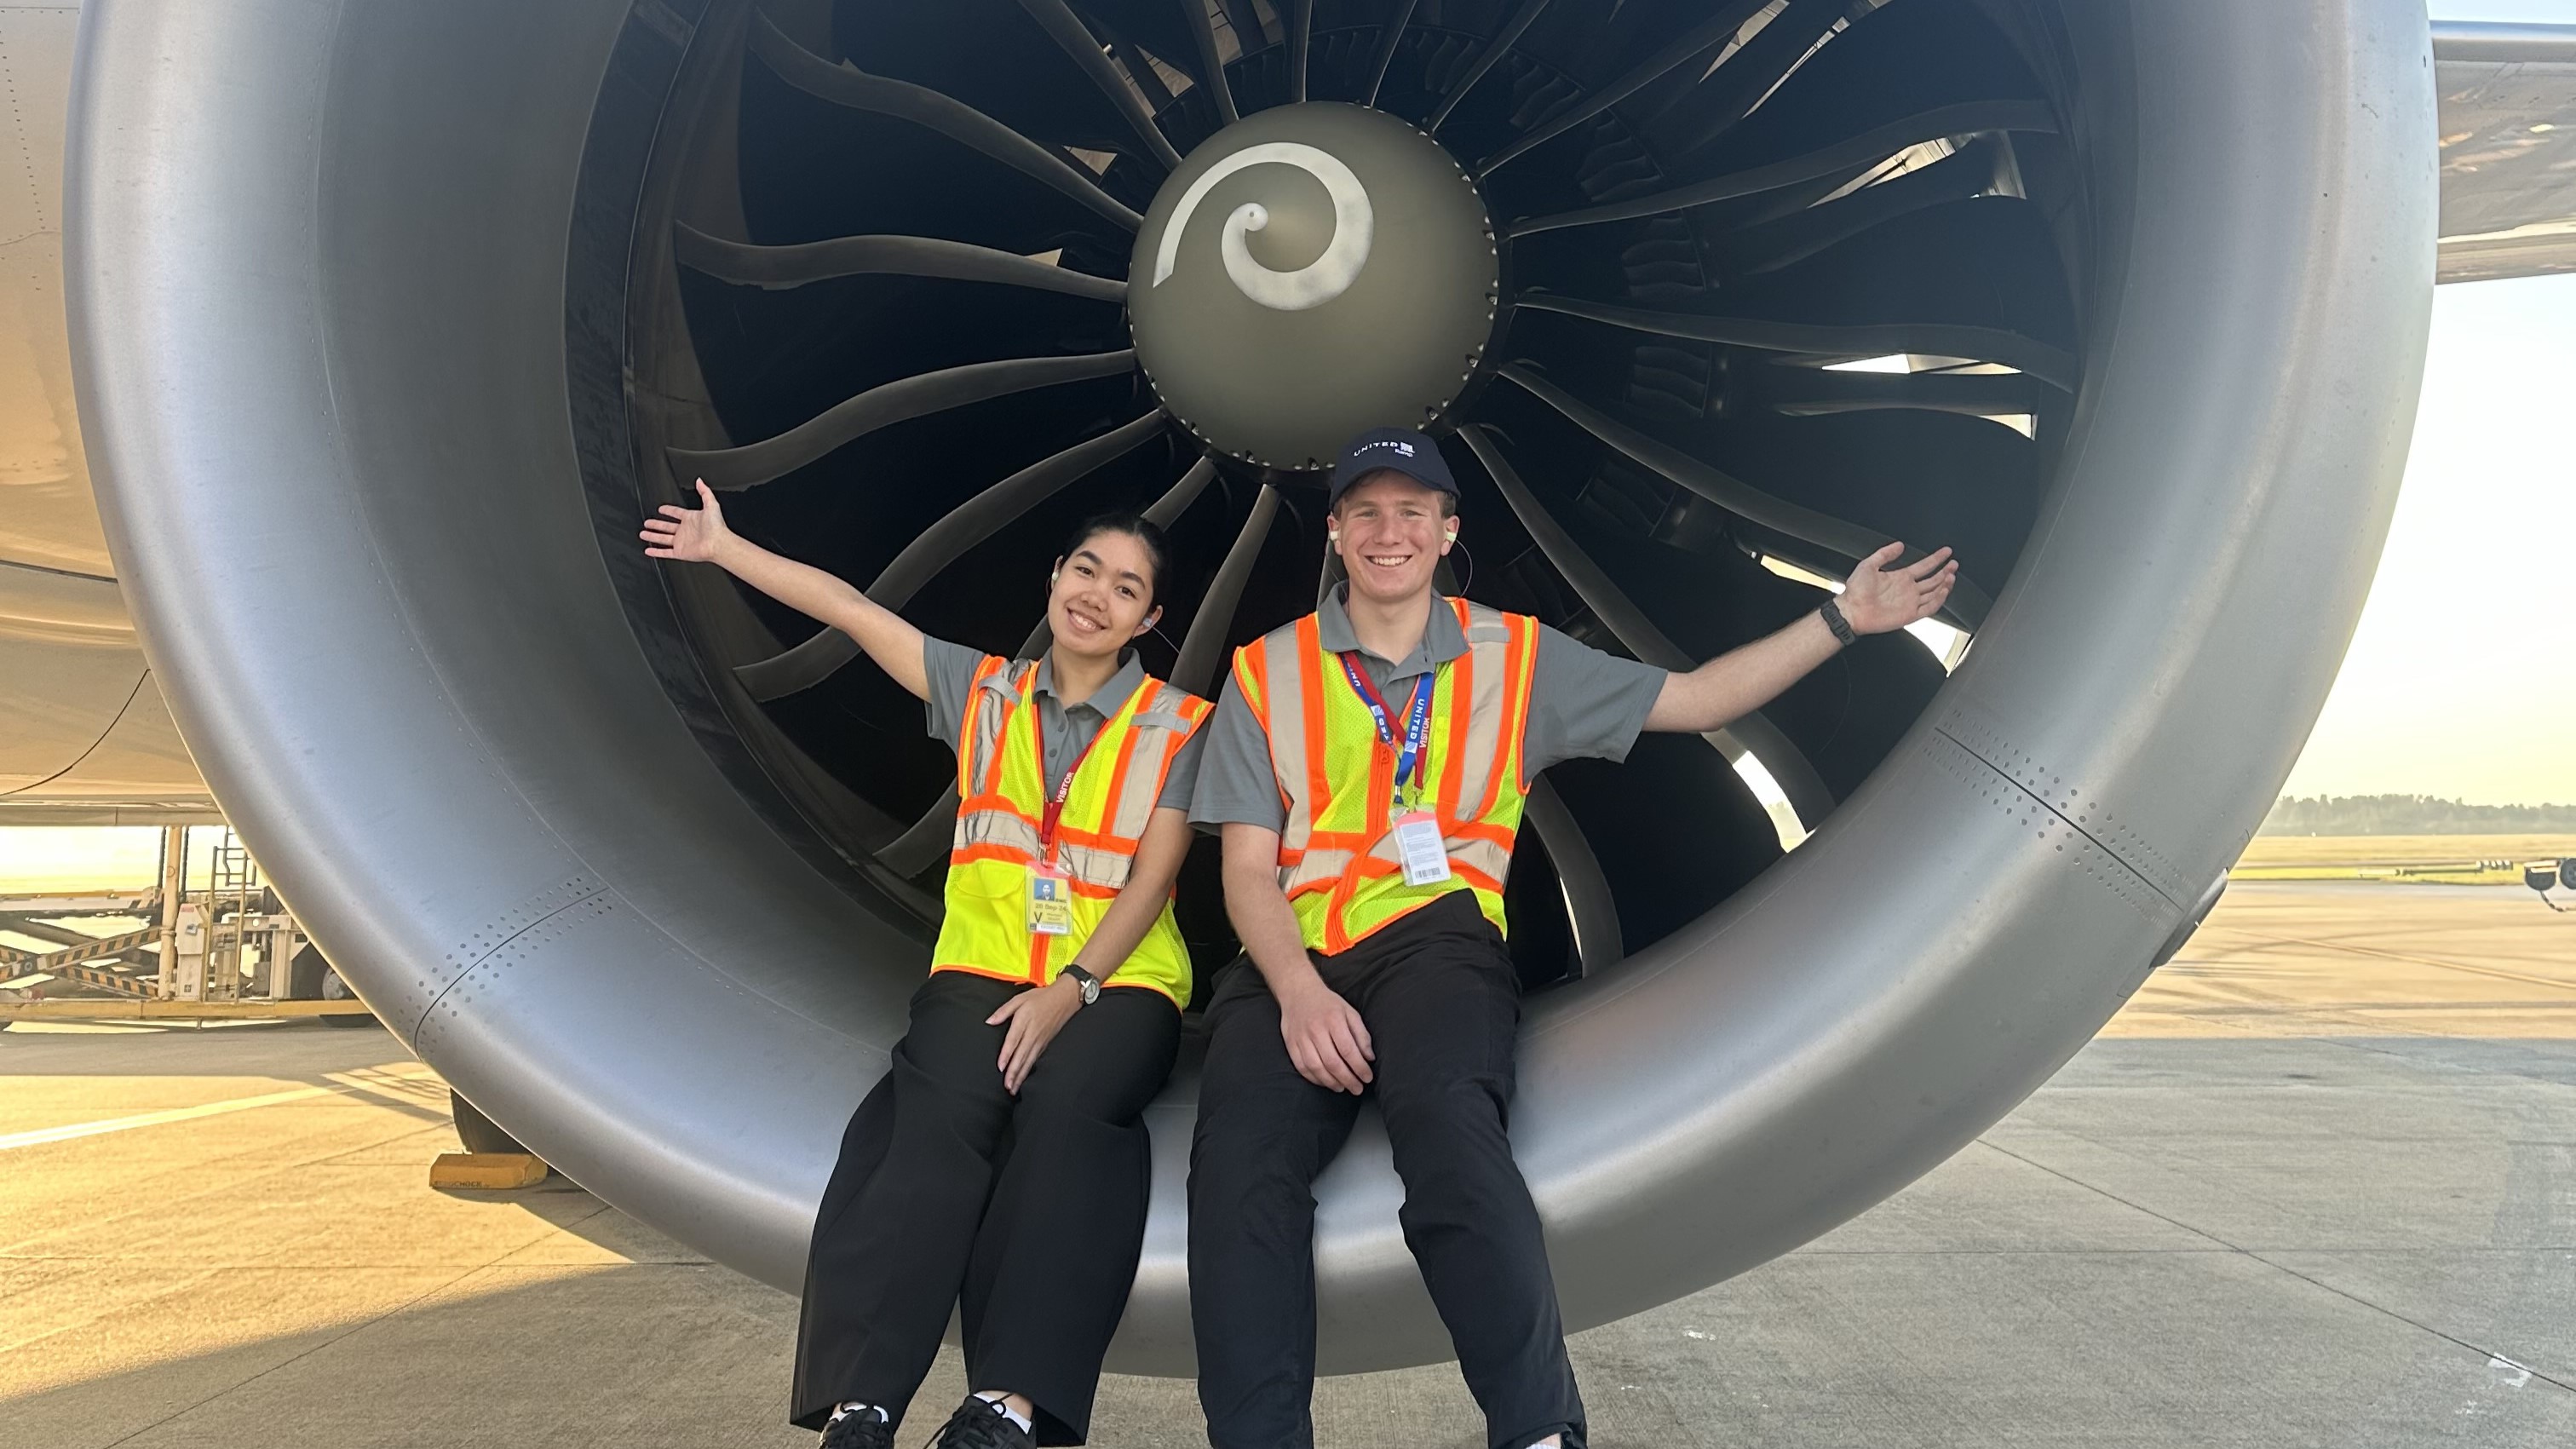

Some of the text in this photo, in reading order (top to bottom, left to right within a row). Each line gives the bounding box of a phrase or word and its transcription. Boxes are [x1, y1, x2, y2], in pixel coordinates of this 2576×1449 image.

[1354, 441, 1398, 457] UNITED
[1410, 699, 1425, 739] UNITED
[1056, 772, 1074, 803] VISITOR
[1034, 911, 1043, 923] V
